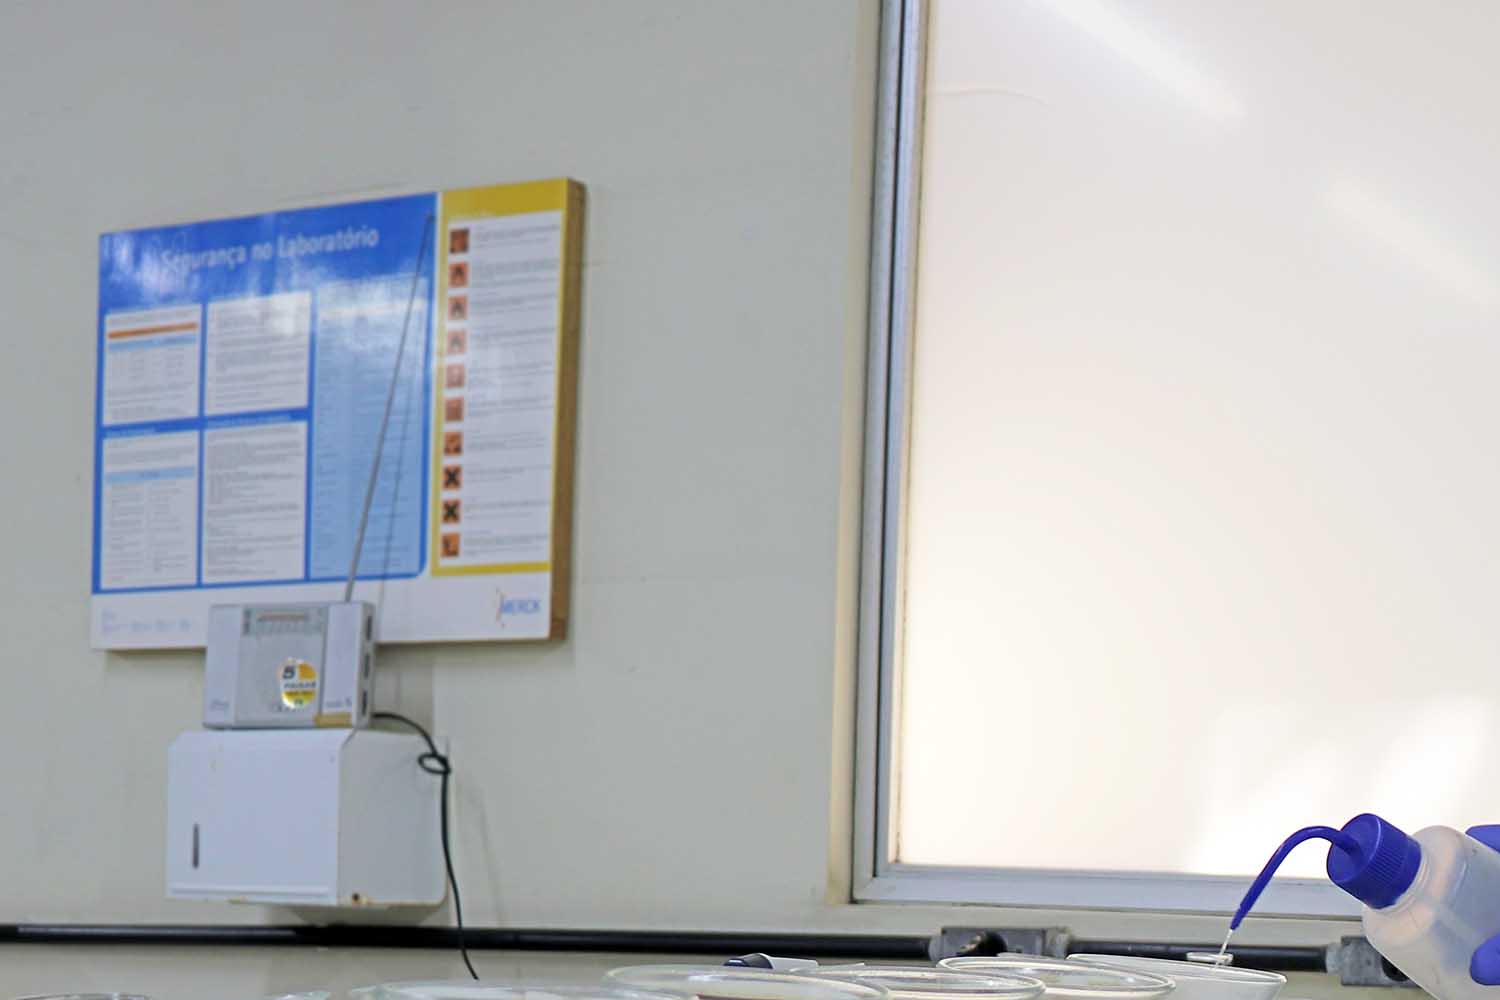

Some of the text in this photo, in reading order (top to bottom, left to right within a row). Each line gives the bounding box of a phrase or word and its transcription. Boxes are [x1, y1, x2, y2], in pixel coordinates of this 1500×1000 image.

[161, 225, 380, 274] Segurança no Laboratório
